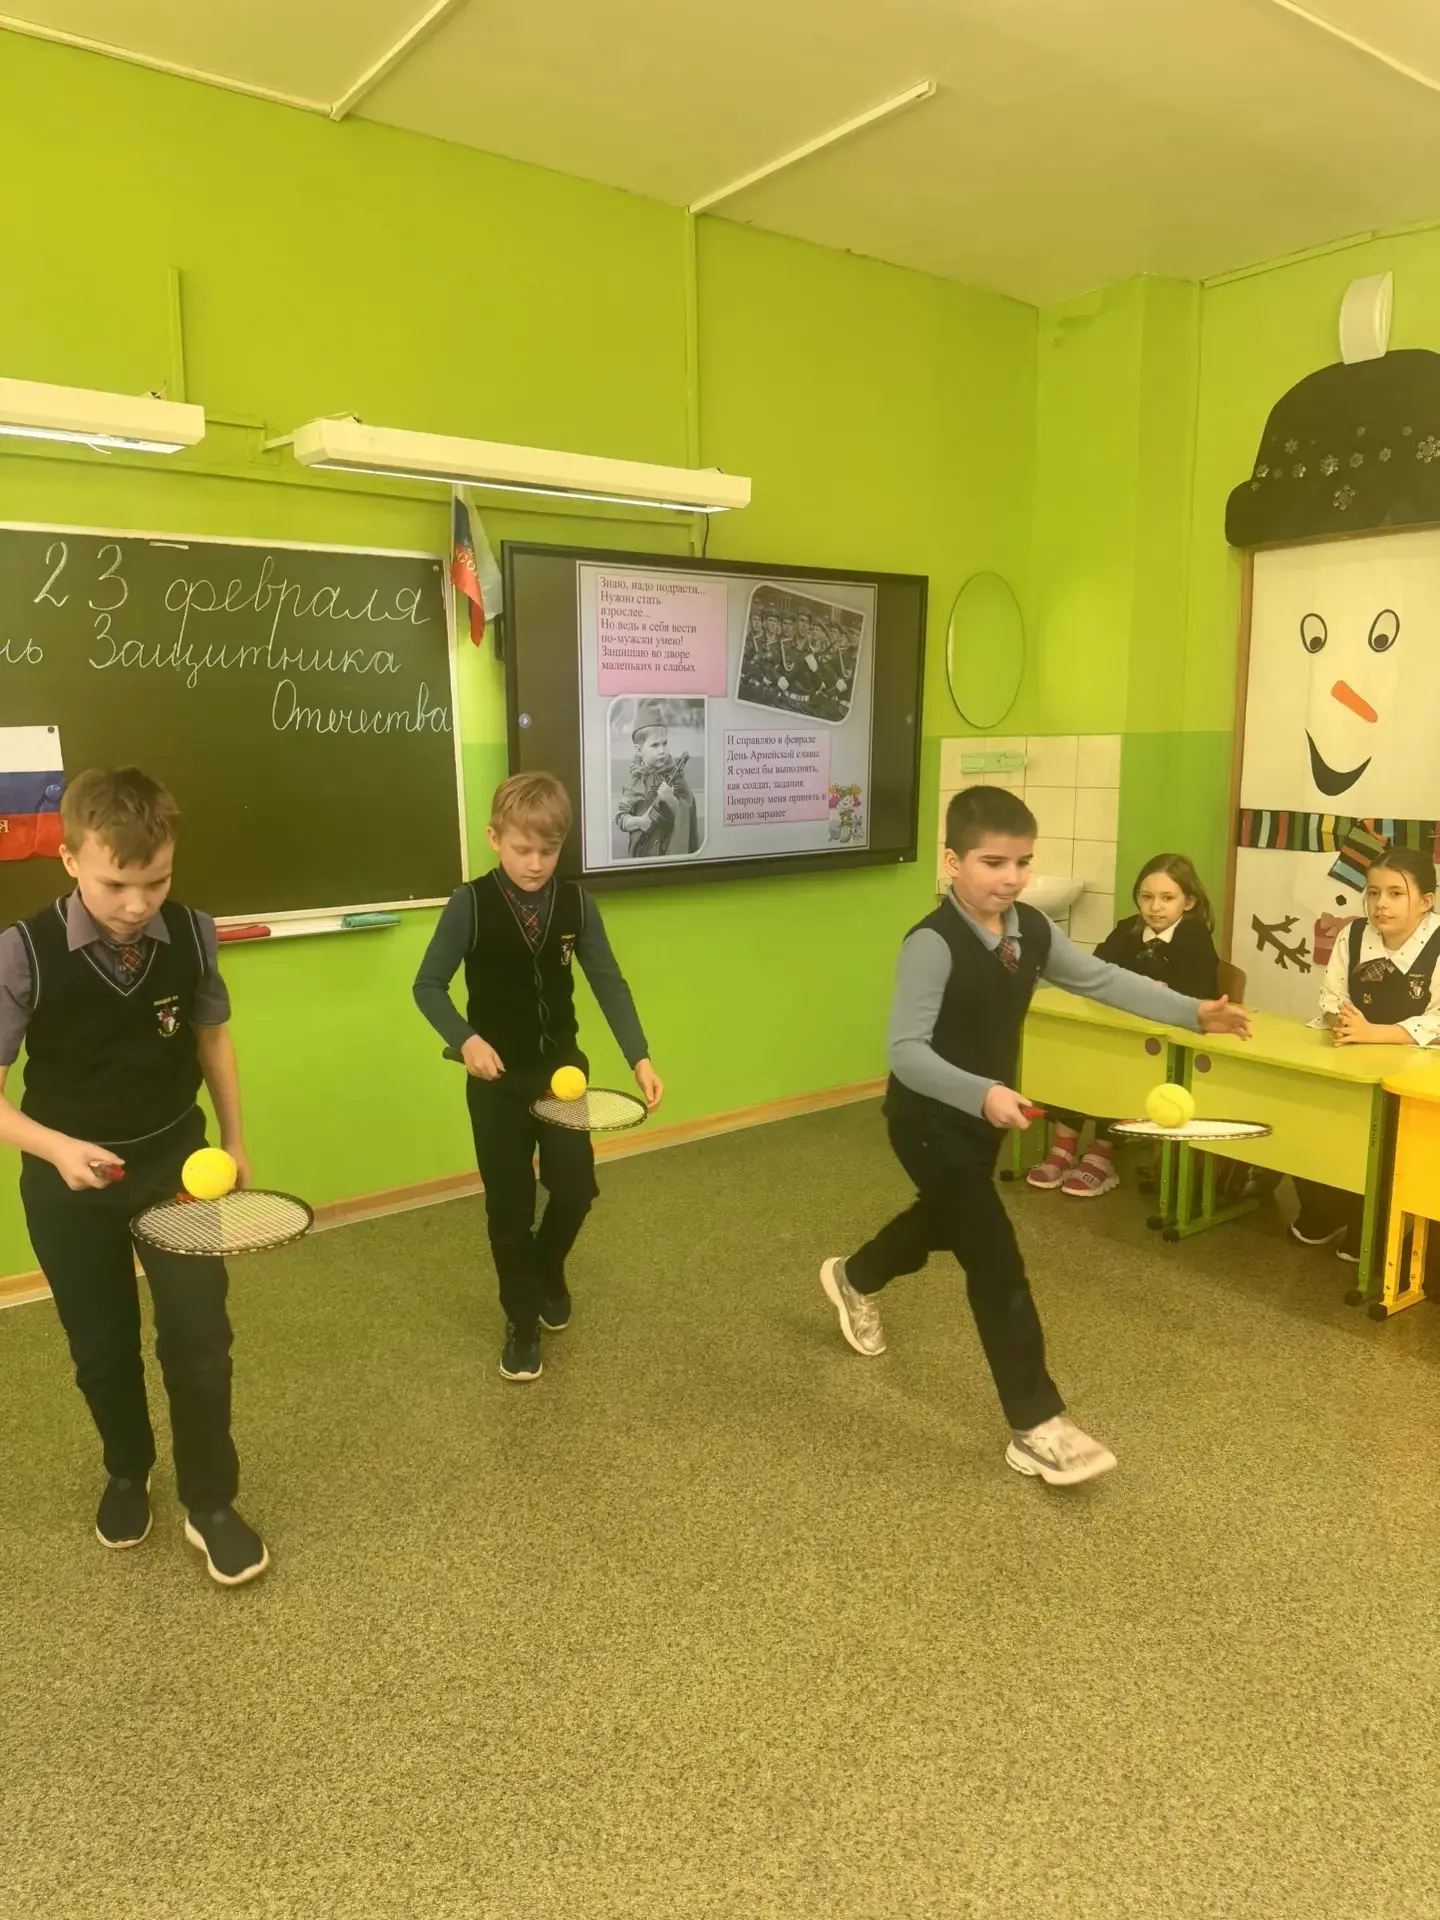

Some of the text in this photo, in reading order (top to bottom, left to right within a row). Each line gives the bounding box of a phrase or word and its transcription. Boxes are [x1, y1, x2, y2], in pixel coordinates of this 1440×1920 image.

[600, 576, 628, 590] Знаю,
[631, 582, 654, 591] надо
[600, 590, 662, 604] Нужно стать
[164, 556, 431, 668] февраля
[601, 618, 614, 630] Но
[618, 622, 639, 632] ведь
[649, 621, 669, 632] себя
[672, 625, 696, 633] вести
[601, 634, 684, 648] по-мужски умею!
[88, 613, 402, 689] Защитника
[664, 652, 690, 662] дворе
[602, 660, 696, 672] маленьких и слабых
[272, 679, 452, 734] Отечества
[727, 736, 734, 744] И
[736, 736, 776, 747] справляю
[784, 734, 816, 746] феврале
[726, 750, 748, 762] День
[750, 750, 794, 762] Армейской
[727, 766, 734, 775] Я
[736, 766, 760, 778] сумел
[762, 764, 774, 774] бы
[727, 795, 766, 807] Попрошу
[768, 795, 786, 803] меня
[789, 794, 820, 804] принять
[726, 810, 787, 823] армию заранее
